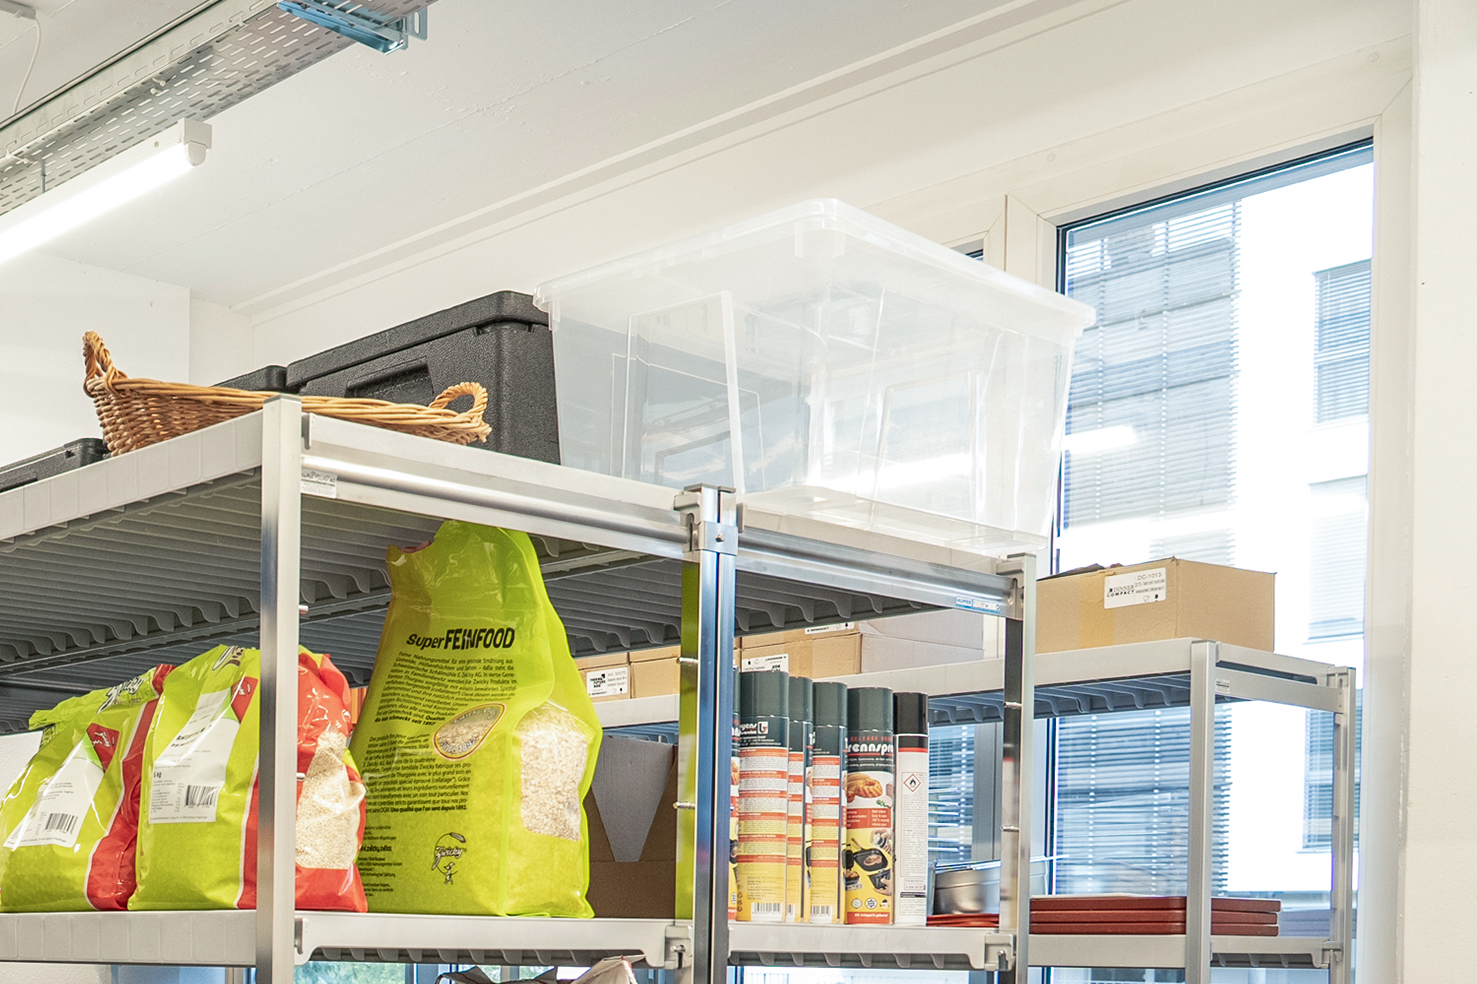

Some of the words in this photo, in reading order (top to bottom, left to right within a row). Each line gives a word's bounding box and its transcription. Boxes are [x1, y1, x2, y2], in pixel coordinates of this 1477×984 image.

[1137, 572, 1162, 581] DC-1013
[1107, 590, 1135, 598] COMPACT
[414, 654, 450, 664] Nahrungsmittel
[404, 675, 424, 683] Thurgau
